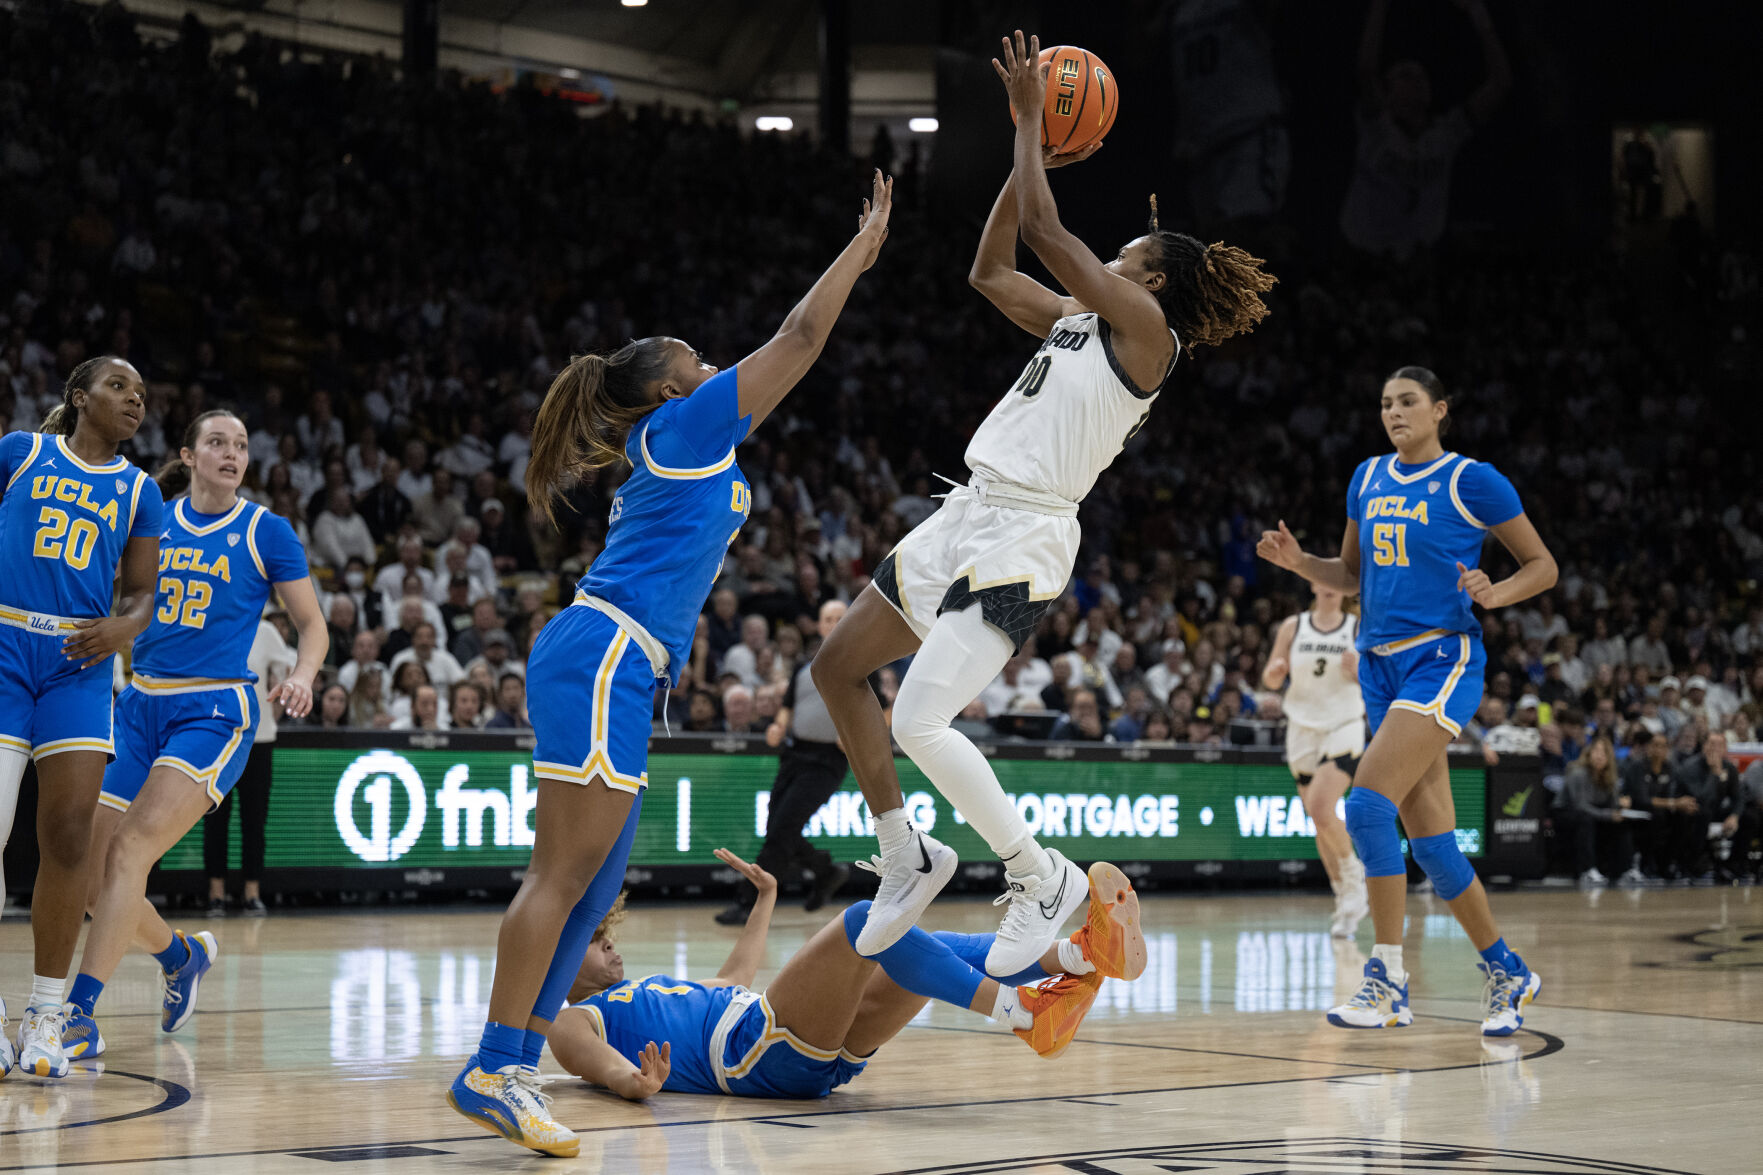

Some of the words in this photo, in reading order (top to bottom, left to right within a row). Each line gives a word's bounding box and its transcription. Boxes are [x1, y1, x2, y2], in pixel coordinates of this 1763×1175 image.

[1056, 58, 1079, 117] ELITE
[30, 474, 119, 532] UCLA
[1365, 496, 1429, 526] UCLA
[33, 507, 99, 571] 20
[1372, 523, 1411, 567] 51
[158, 548, 231, 584] UCLA
[31, 616, 55, 632] Ucla
[157, 578, 212, 629] 32
[1313, 657, 1327, 677] 3
[1006, 793, 1179, 838] ORTGAGE
[1234, 795, 1347, 837] WEA
